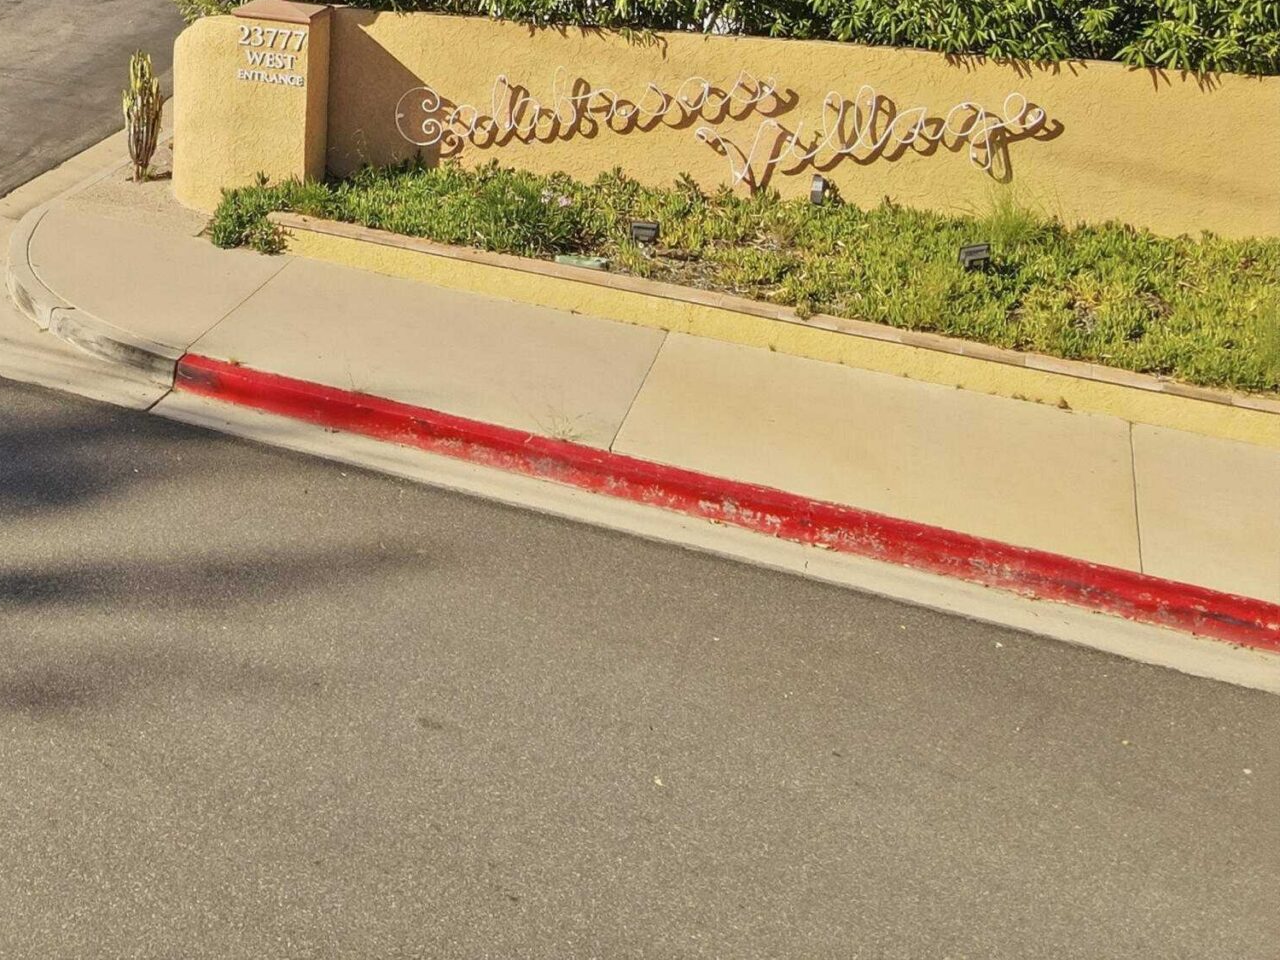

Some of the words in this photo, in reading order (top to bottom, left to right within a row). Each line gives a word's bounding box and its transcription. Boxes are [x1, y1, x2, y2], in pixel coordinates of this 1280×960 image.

[238, 25, 307, 52] 23777
[246, 50, 297, 70] WEST
[238, 69, 304, 87] ENTRANCE
[395, 66, 776, 145] Calabasas
[695, 85, 1045, 185] Village
